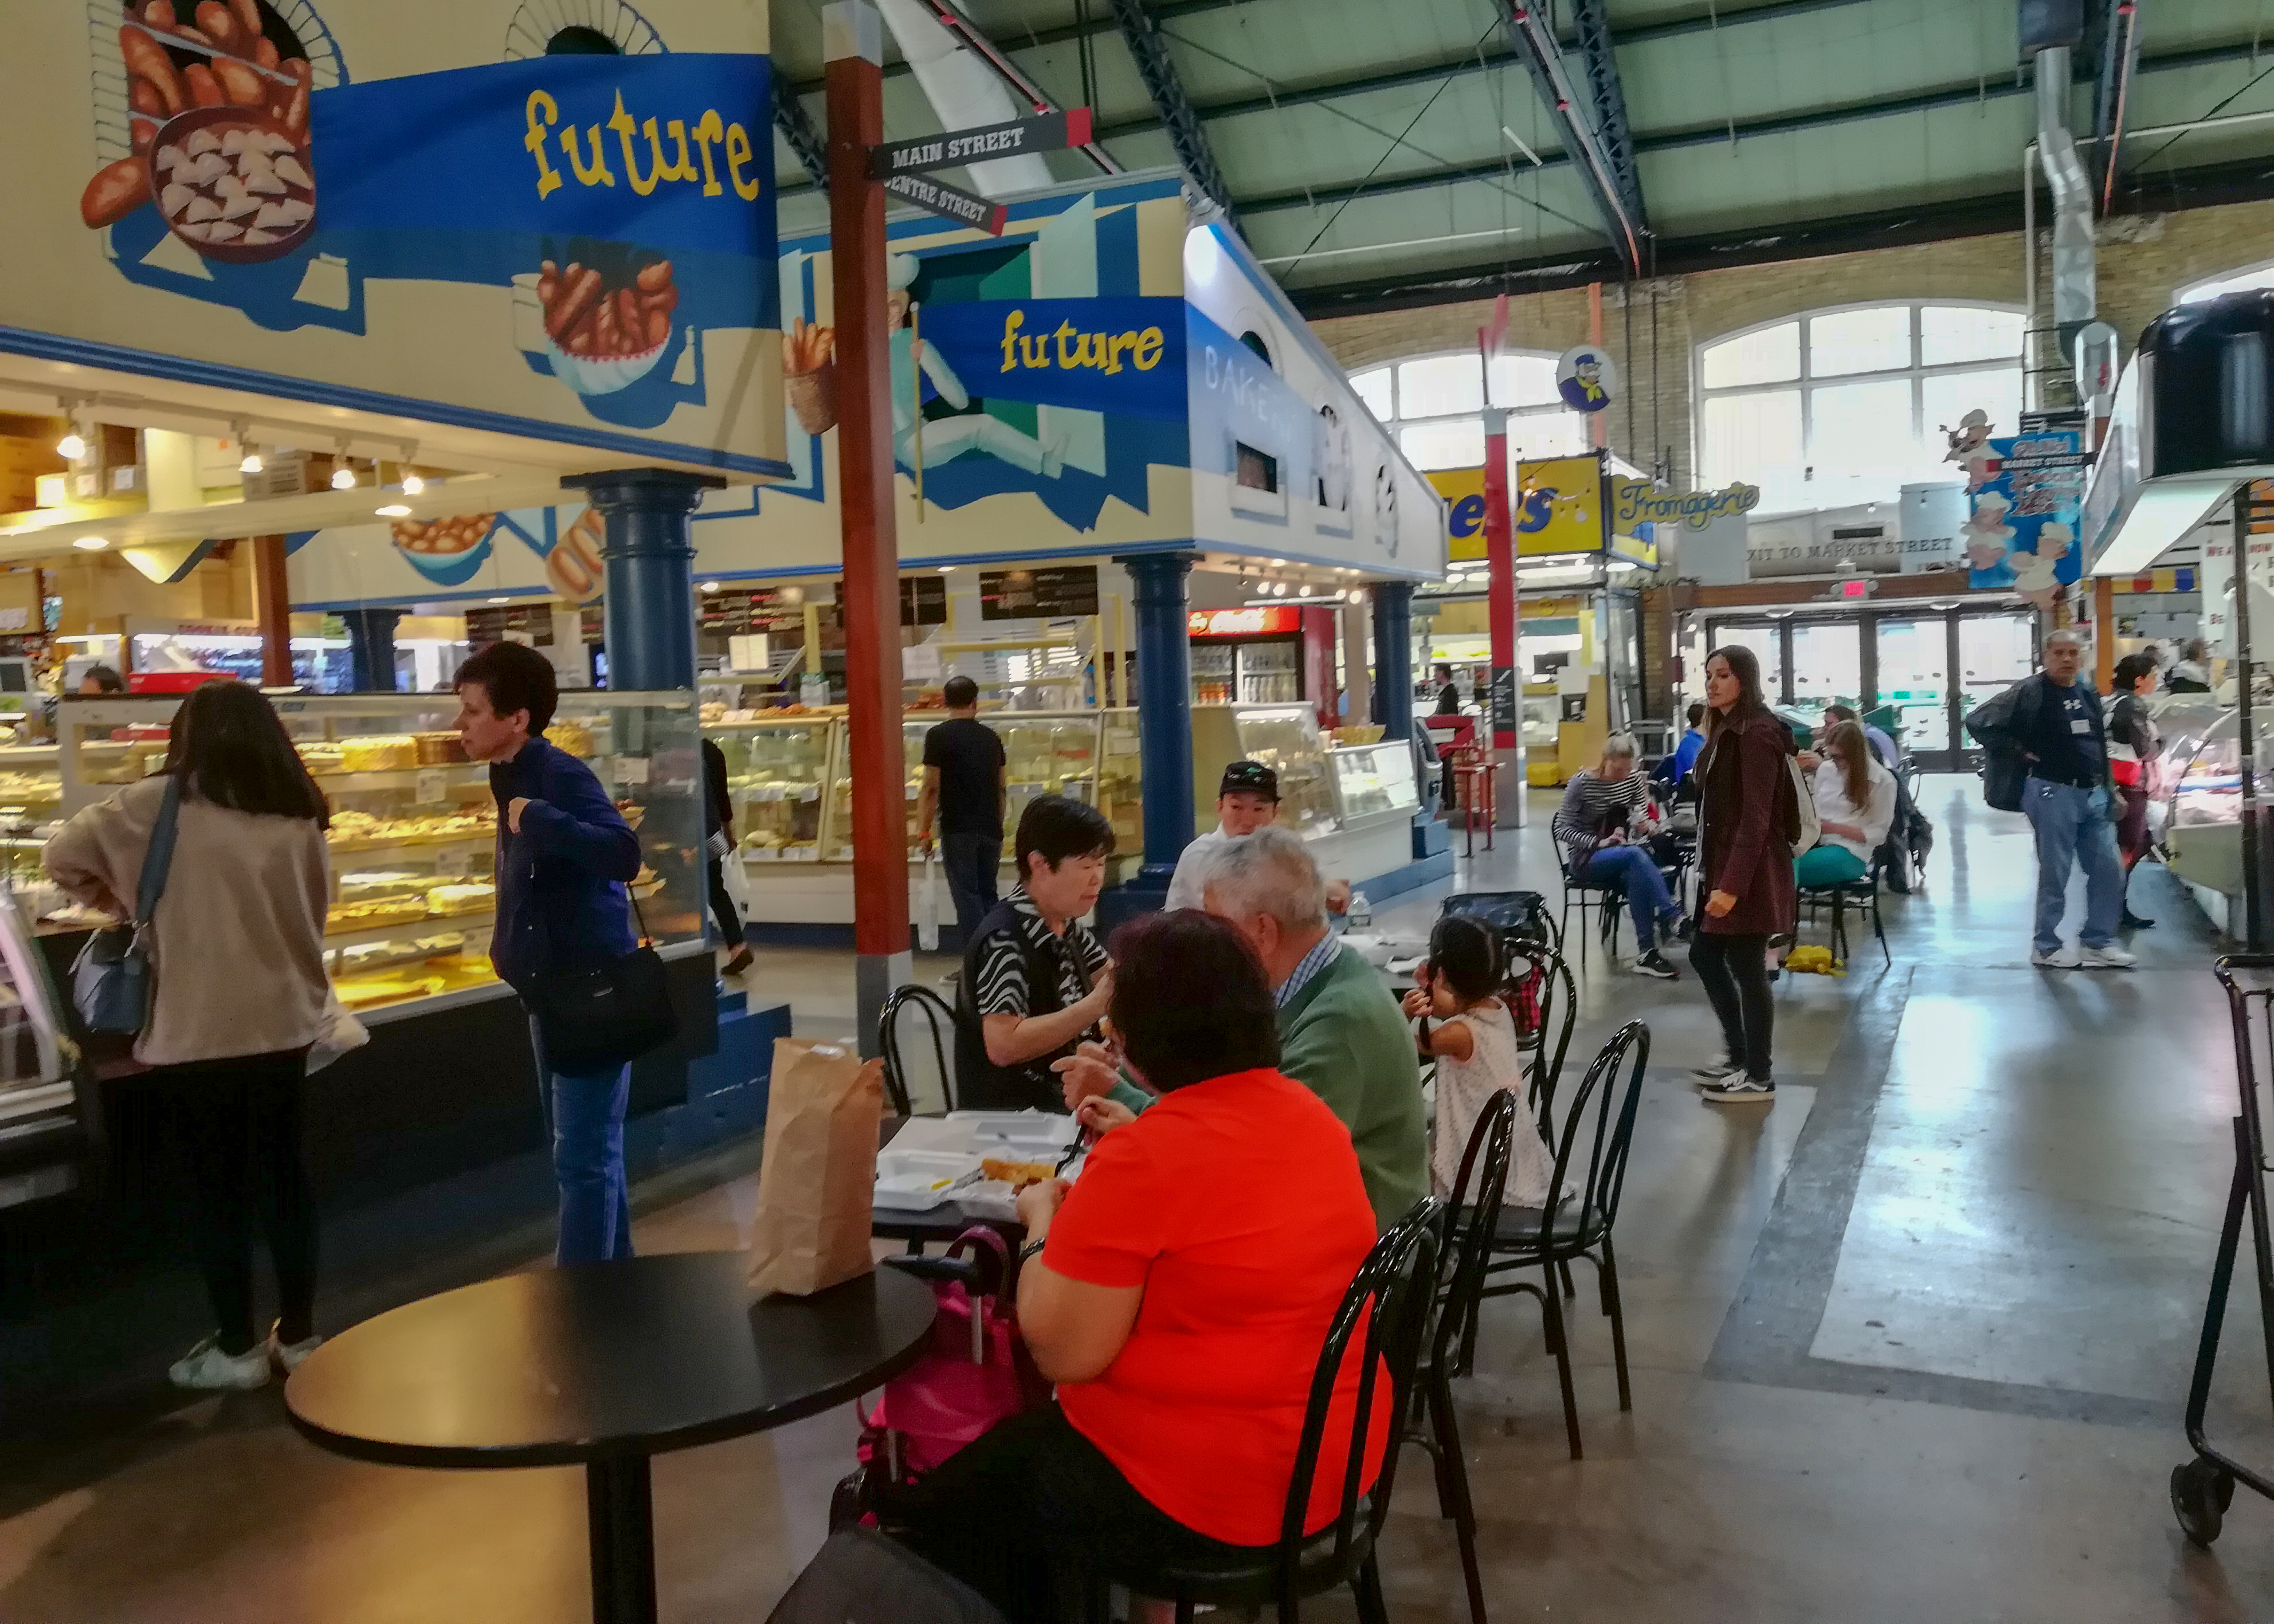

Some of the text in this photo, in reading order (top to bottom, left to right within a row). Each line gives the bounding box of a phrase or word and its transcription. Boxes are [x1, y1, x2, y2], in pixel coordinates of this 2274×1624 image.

[524, 87, 759, 201] future
[892, 126, 1025, 169] MAIN STREET
[937, 190, 987, 222] STREET
[1000, 309, 1164, 376] future
[1619, 483, 1756, 528] Fromagerie
[1746, 537, 1954, 562] XIT TO MARKET STREET
